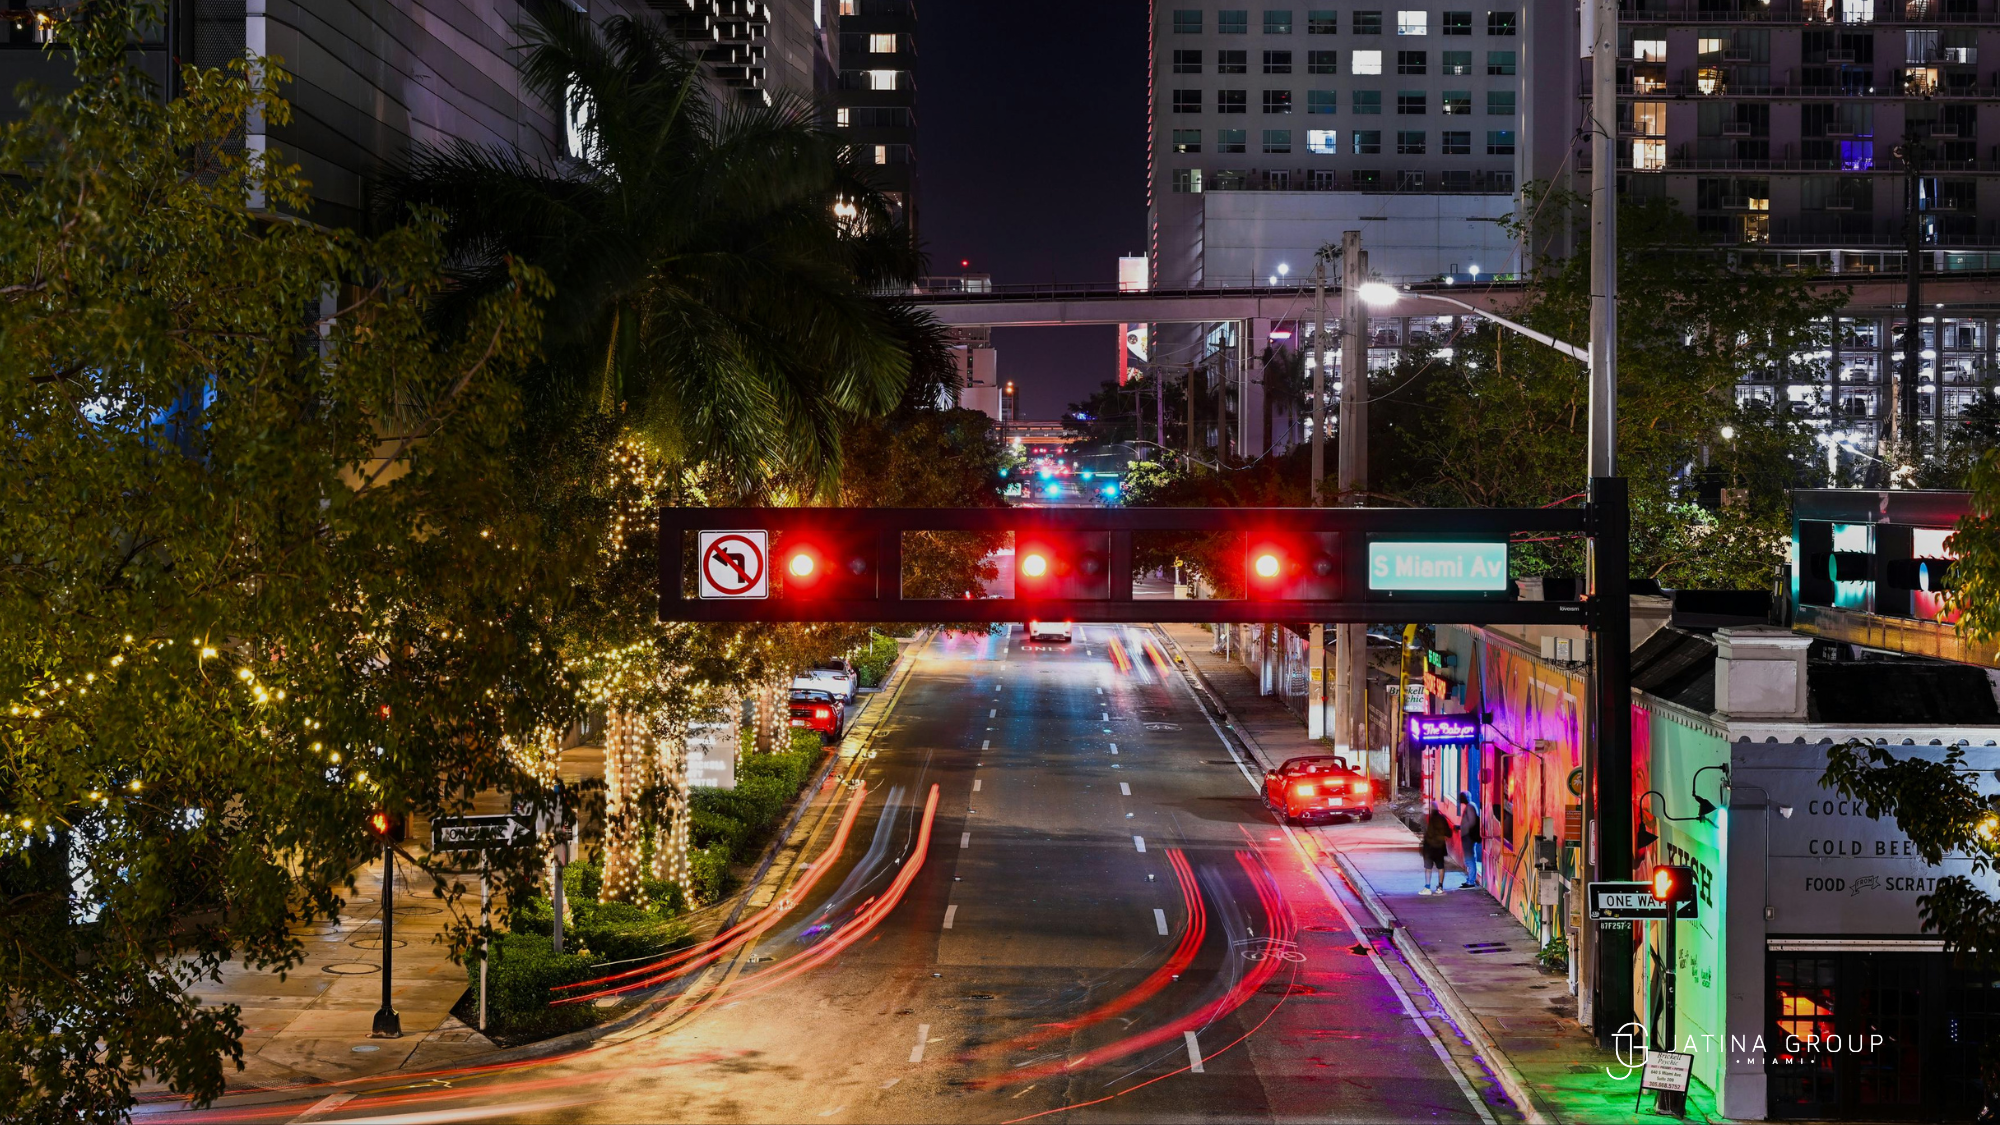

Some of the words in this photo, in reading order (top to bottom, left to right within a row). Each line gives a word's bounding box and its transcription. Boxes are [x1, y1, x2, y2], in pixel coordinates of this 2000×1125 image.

[1373, 555, 1389, 577] S
[1395, 555, 1463, 577] Miami
[1470, 555, 1502, 577] Av
[1422, 722, 1439, 735] The
[1809, 839, 1862, 855] COLD
[1805, 877, 1845, 892] FOOD
[1856, 877, 1873, 887] FROM
[1885, 877, 1936, 892] SCRAT
[1606, 895, 1632, 907] ONE
[1657, 1052, 1682, 1060] Brickell
